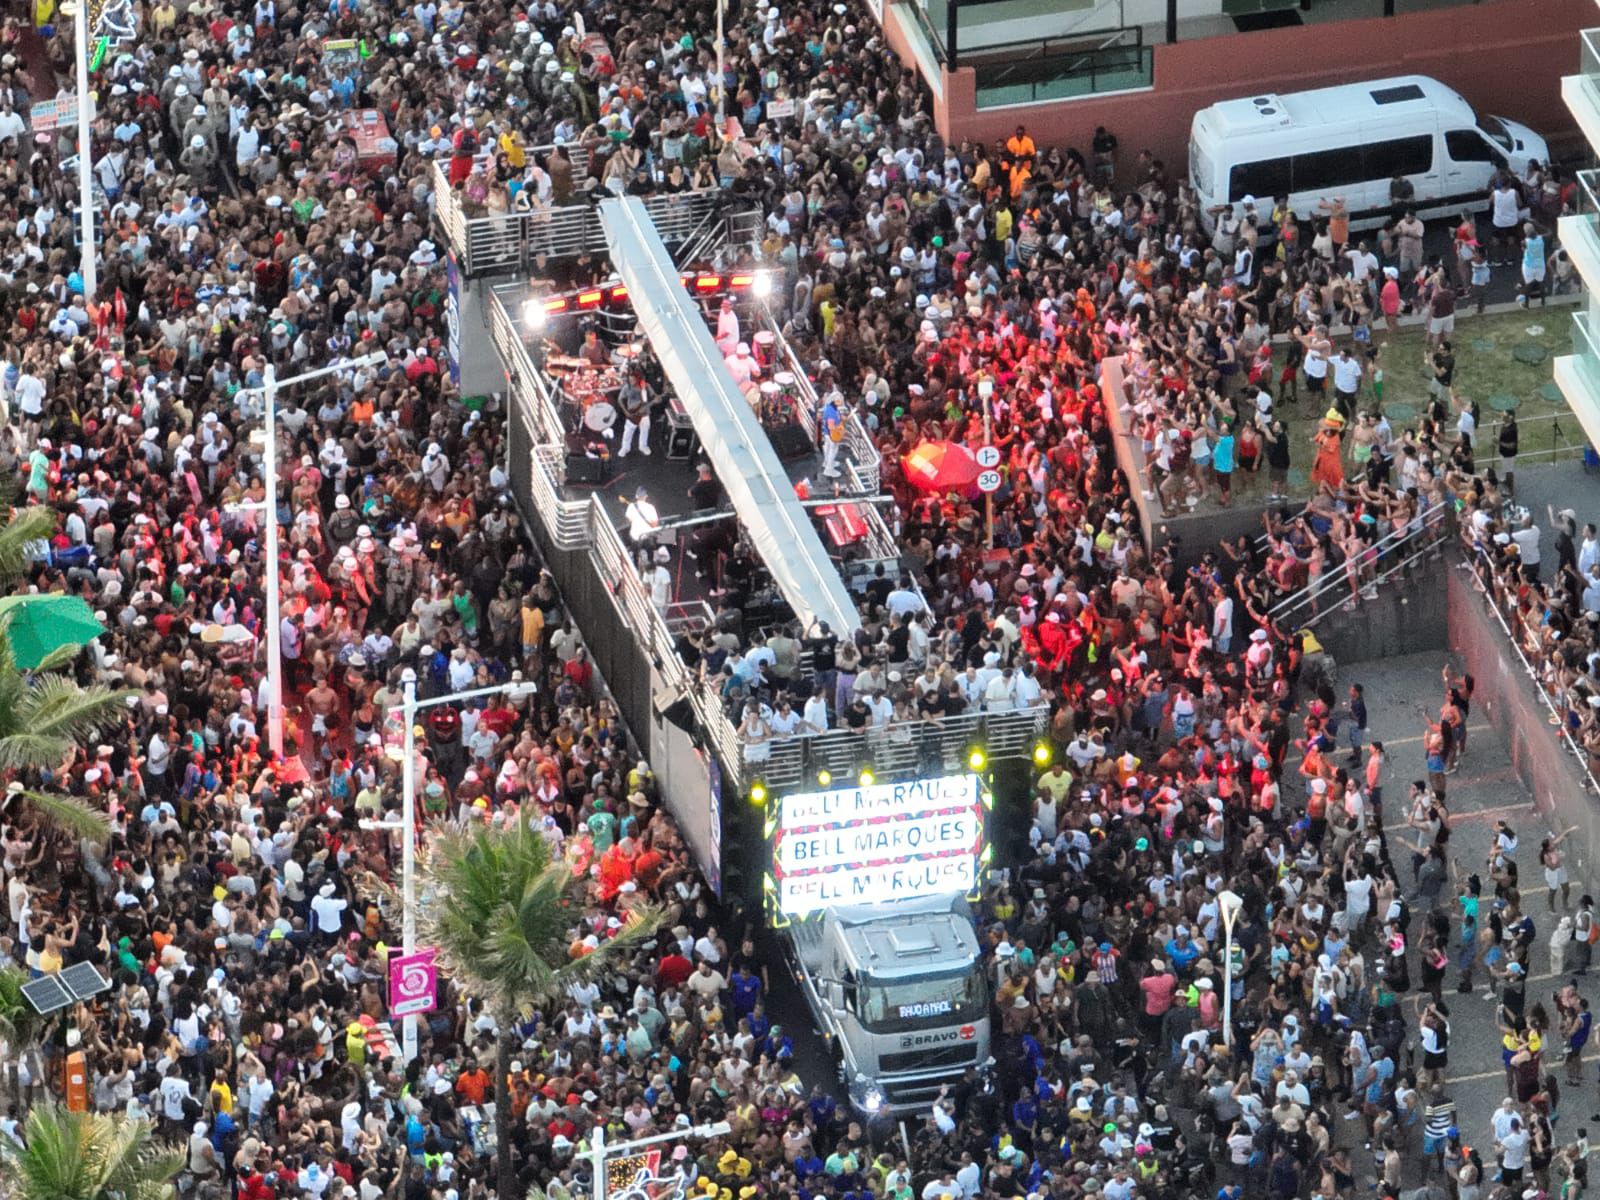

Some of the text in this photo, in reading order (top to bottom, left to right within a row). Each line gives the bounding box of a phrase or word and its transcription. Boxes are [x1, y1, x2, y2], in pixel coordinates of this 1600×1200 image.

[980, 473, 998, 485] 30
[794, 821, 965, 860] BELL MARQUES
[853, 862, 969, 895] MRQUES
[915, 1031, 958, 1045] BRAVO
